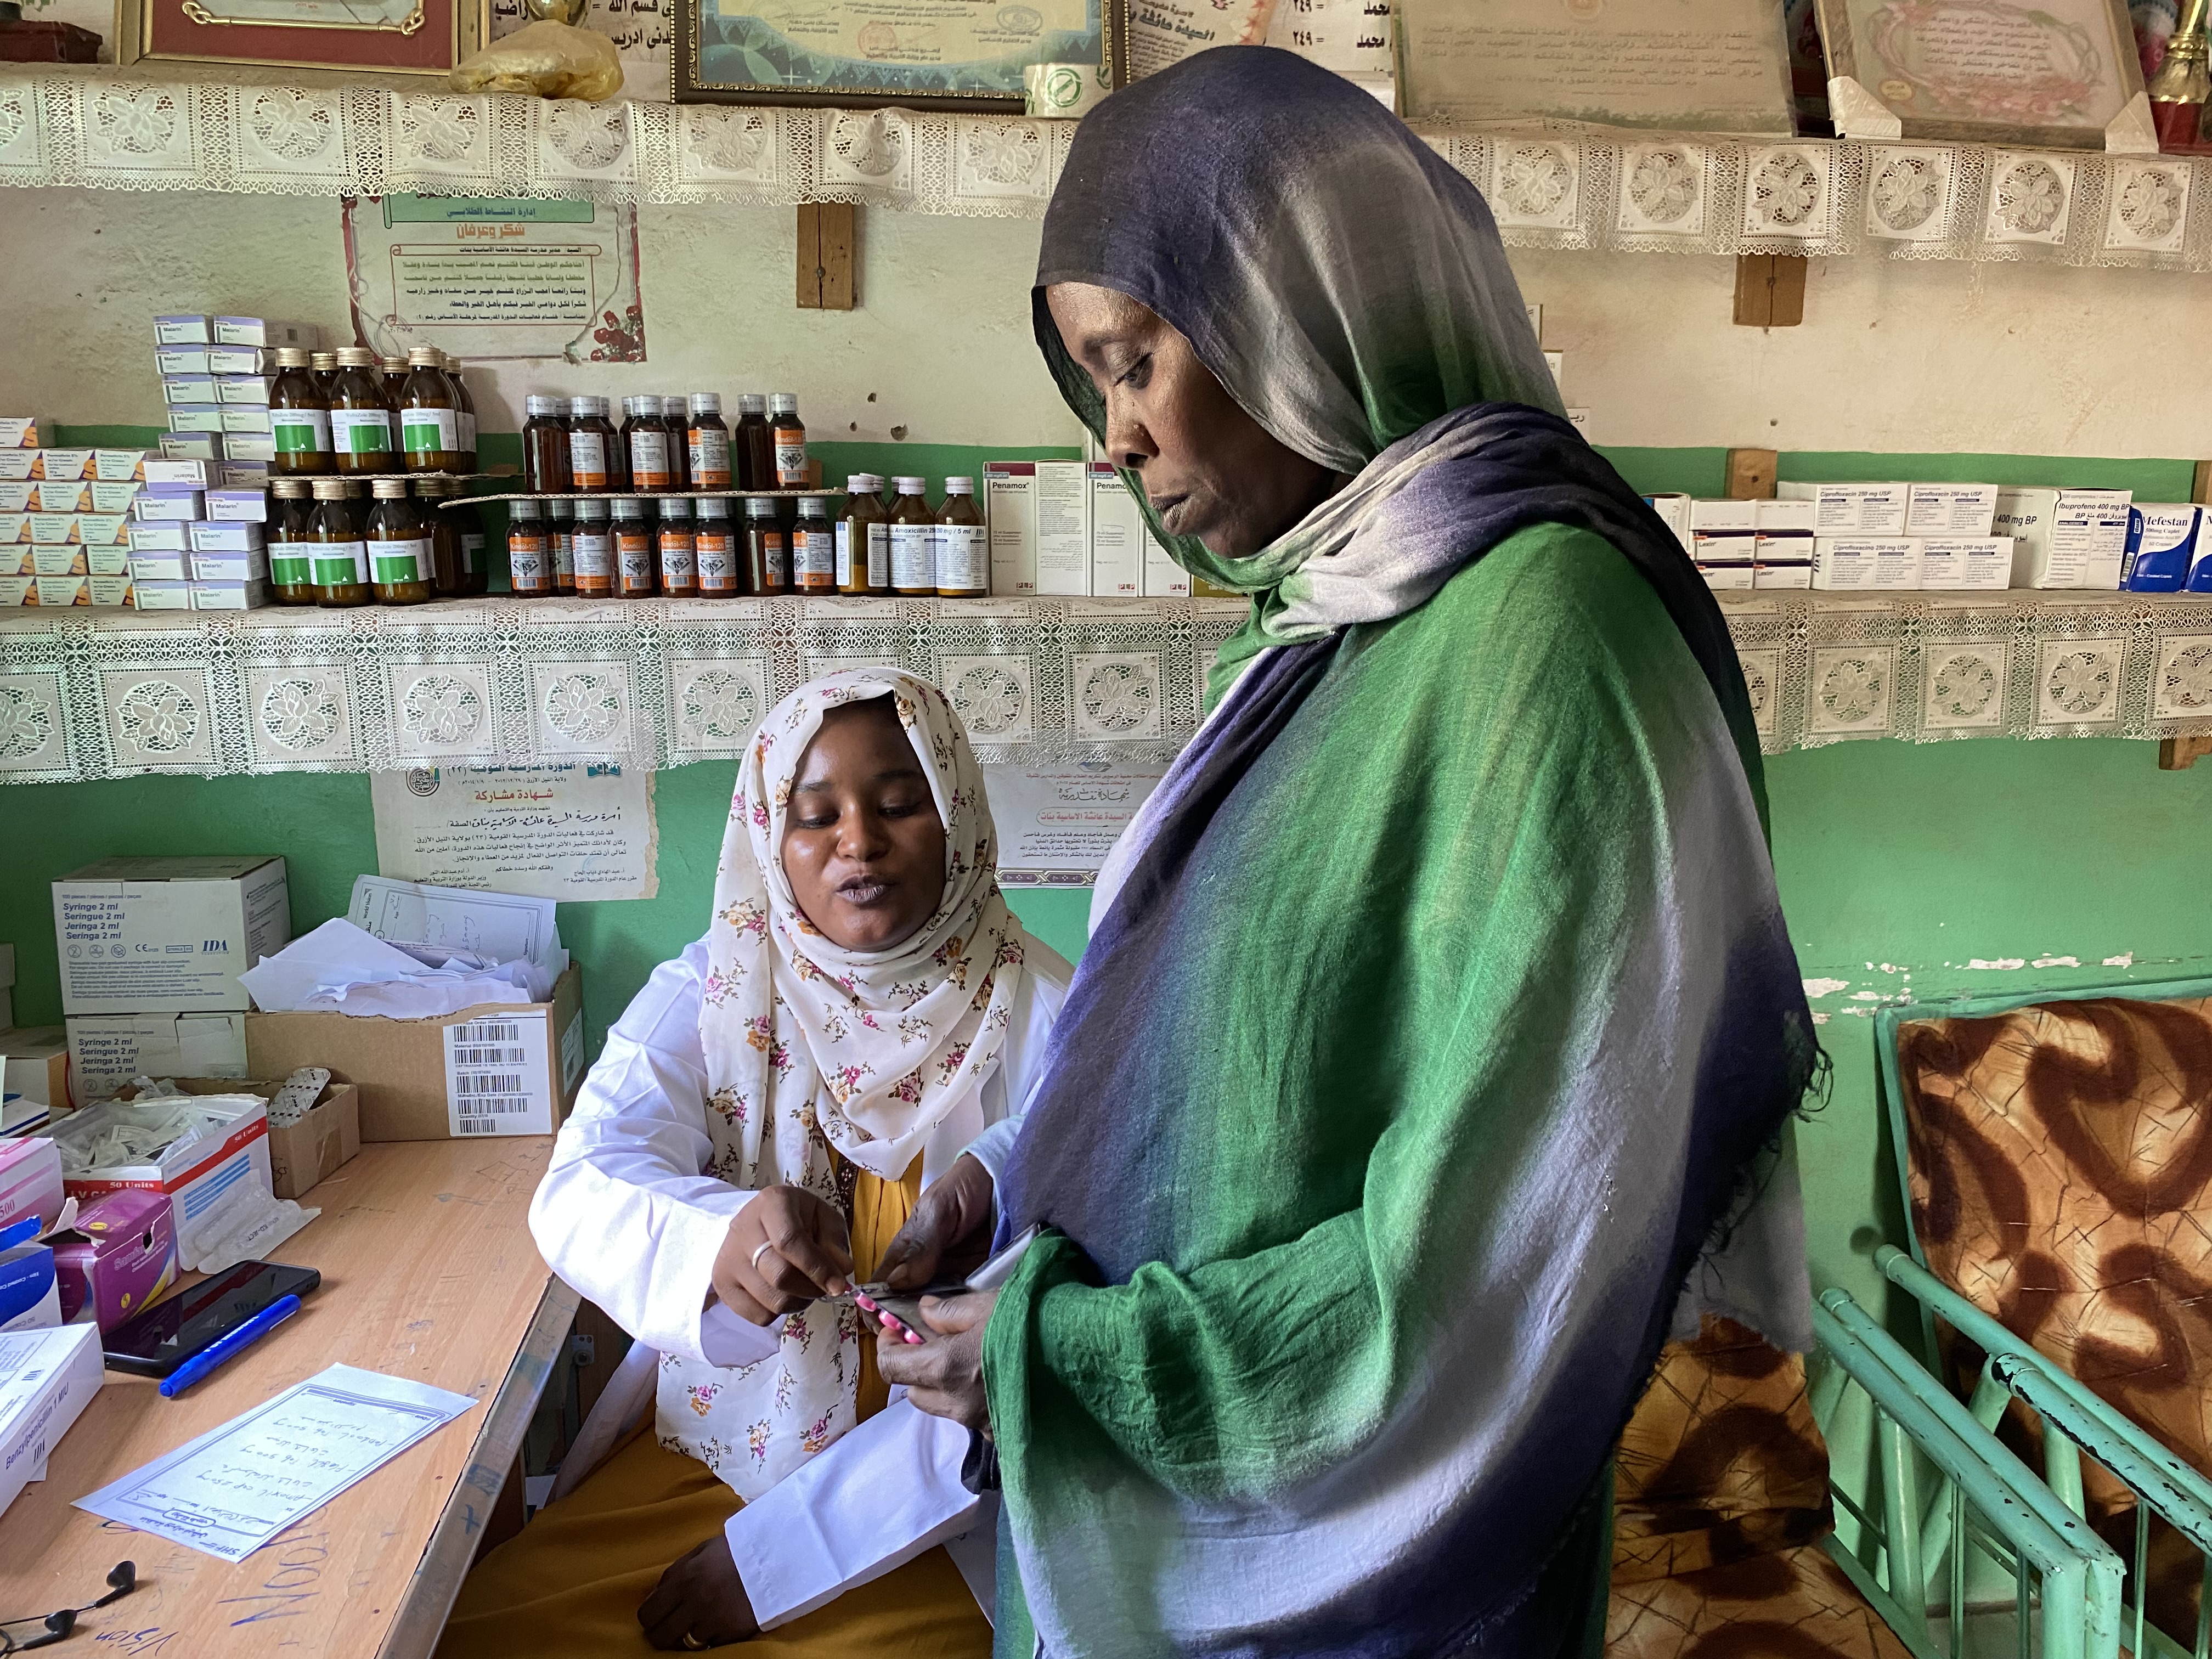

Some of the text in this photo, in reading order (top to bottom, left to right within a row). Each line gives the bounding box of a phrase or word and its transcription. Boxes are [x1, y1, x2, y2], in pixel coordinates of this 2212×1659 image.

[485, 207, 515, 216] النشاط
[456, 223, 525, 239] شكر وعرفان
[1997, 515, 2037, 526] 400 mg BP
[2143, 516, 2188, 526] Mefestan
[475, 788, 554, 803] شهادة مشاركة
[1085, 811, 1103, 821] عائشة
[64, 913, 104, 921] Seringue
[65, 923, 97, 931] Jeringa
[66, 932, 99, 940] Seringa
[202, 940, 228, 952] IDA
[80, 1048, 118, 1056] Seringue
[243, 1125, 259, 1137] Units
[6, 1406, 52, 1470] Benzylpenicillin
